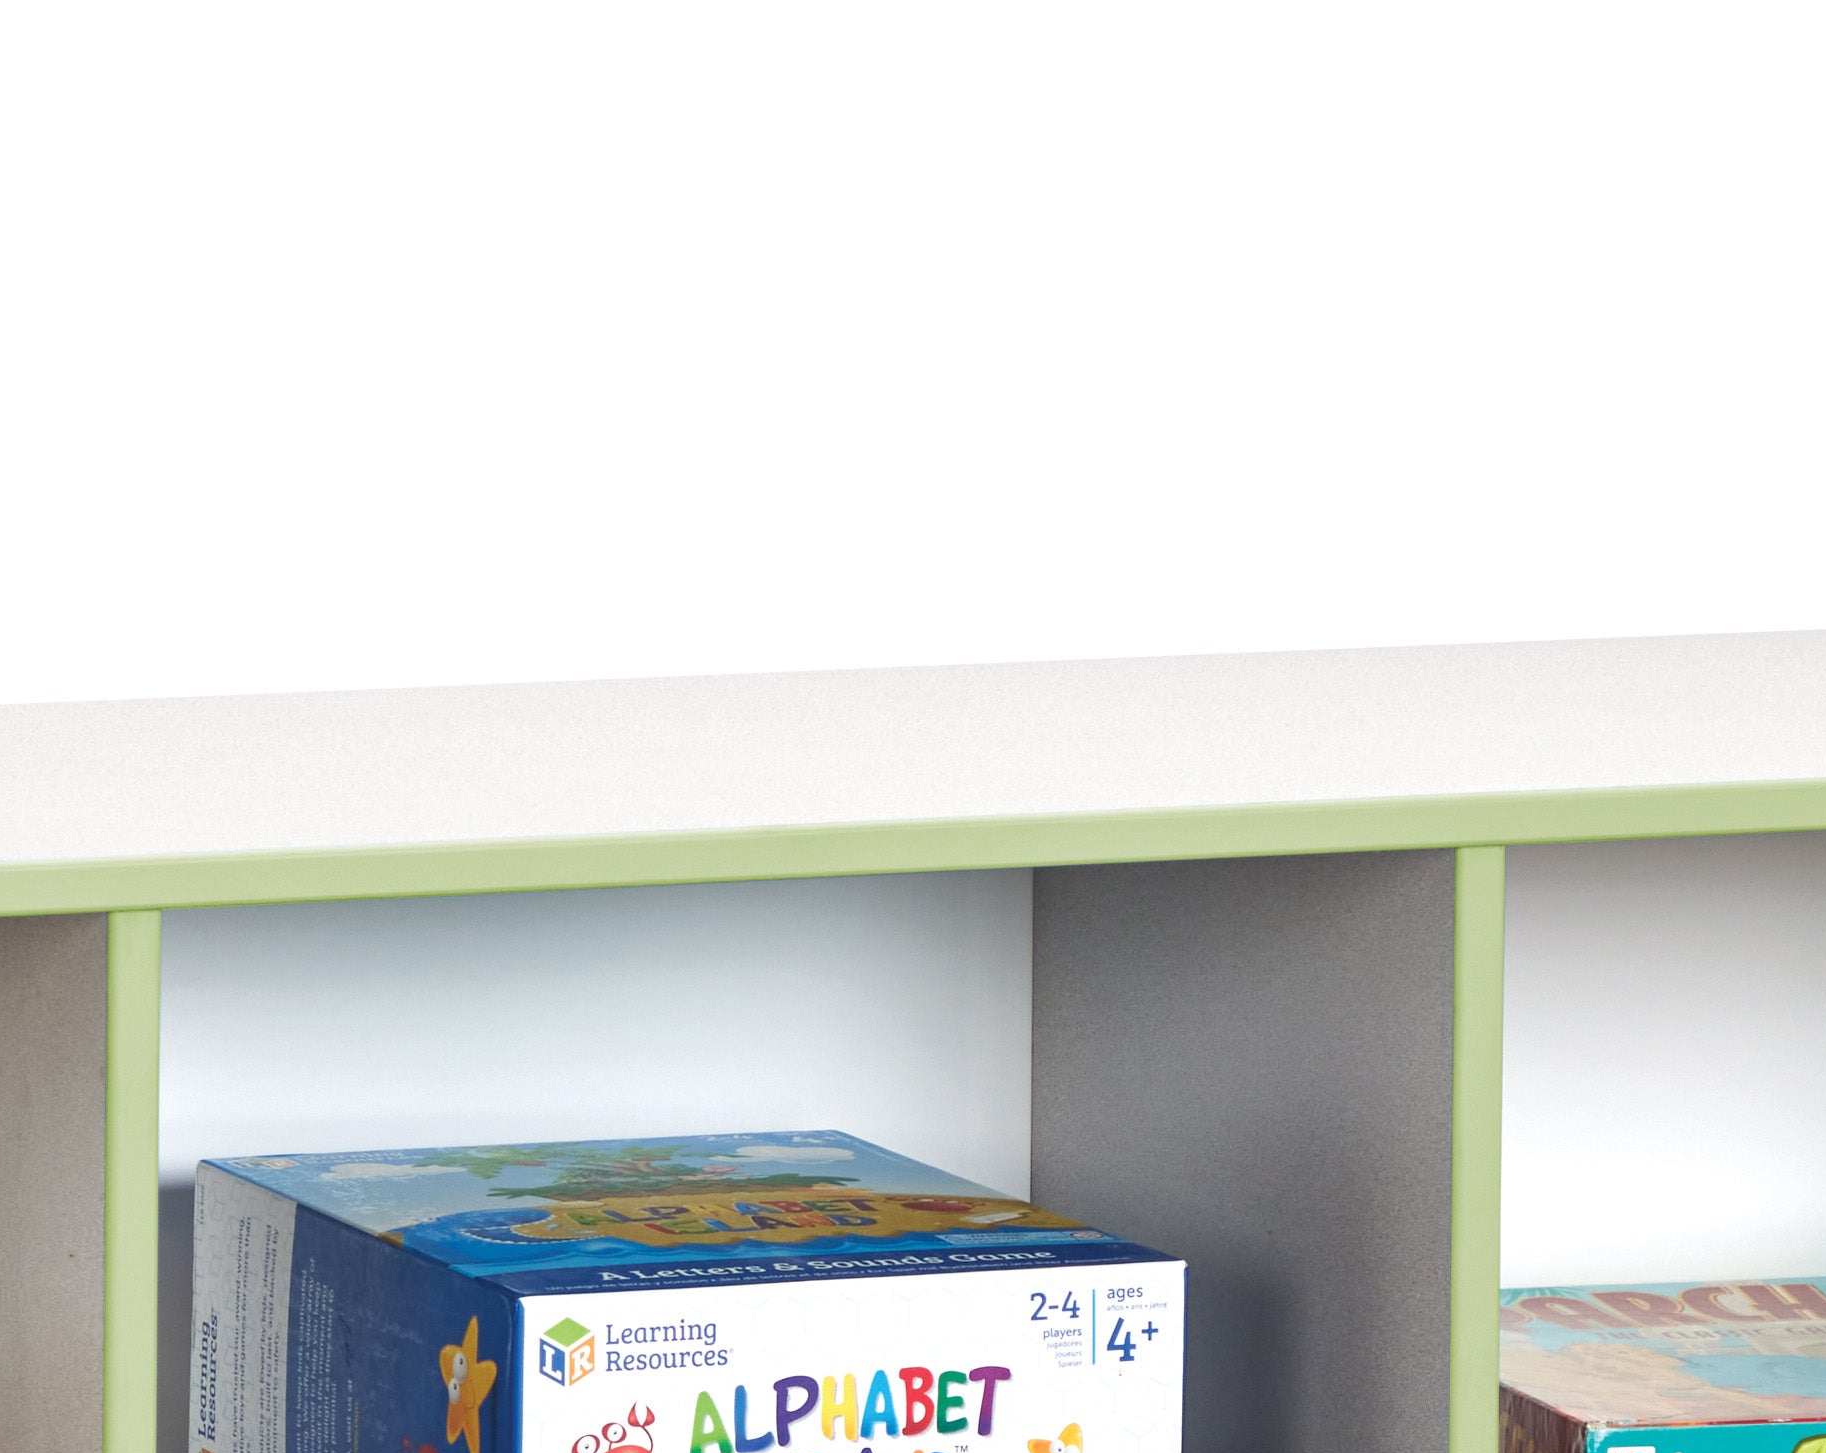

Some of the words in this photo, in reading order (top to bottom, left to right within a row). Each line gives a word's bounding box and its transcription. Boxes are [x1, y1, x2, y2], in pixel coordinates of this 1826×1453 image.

[598, 1270, 631, 1281] A
[635, 1263, 768, 1279] Letters
[769, 1261, 808, 1271] &
[804, 1254, 946, 1270] Sounds
[944, 1249, 1060, 1263] Game
[1030, 1291, 1080, 1321] 2-4
[1107, 1286, 1143, 1302] ages
[606, 1318, 717, 1346] Learning
[1043, 1327, 1082, 1340] players
[1107, 1317, 1159, 1362] 4+
[195, 1319, 210, 1439] Learning
